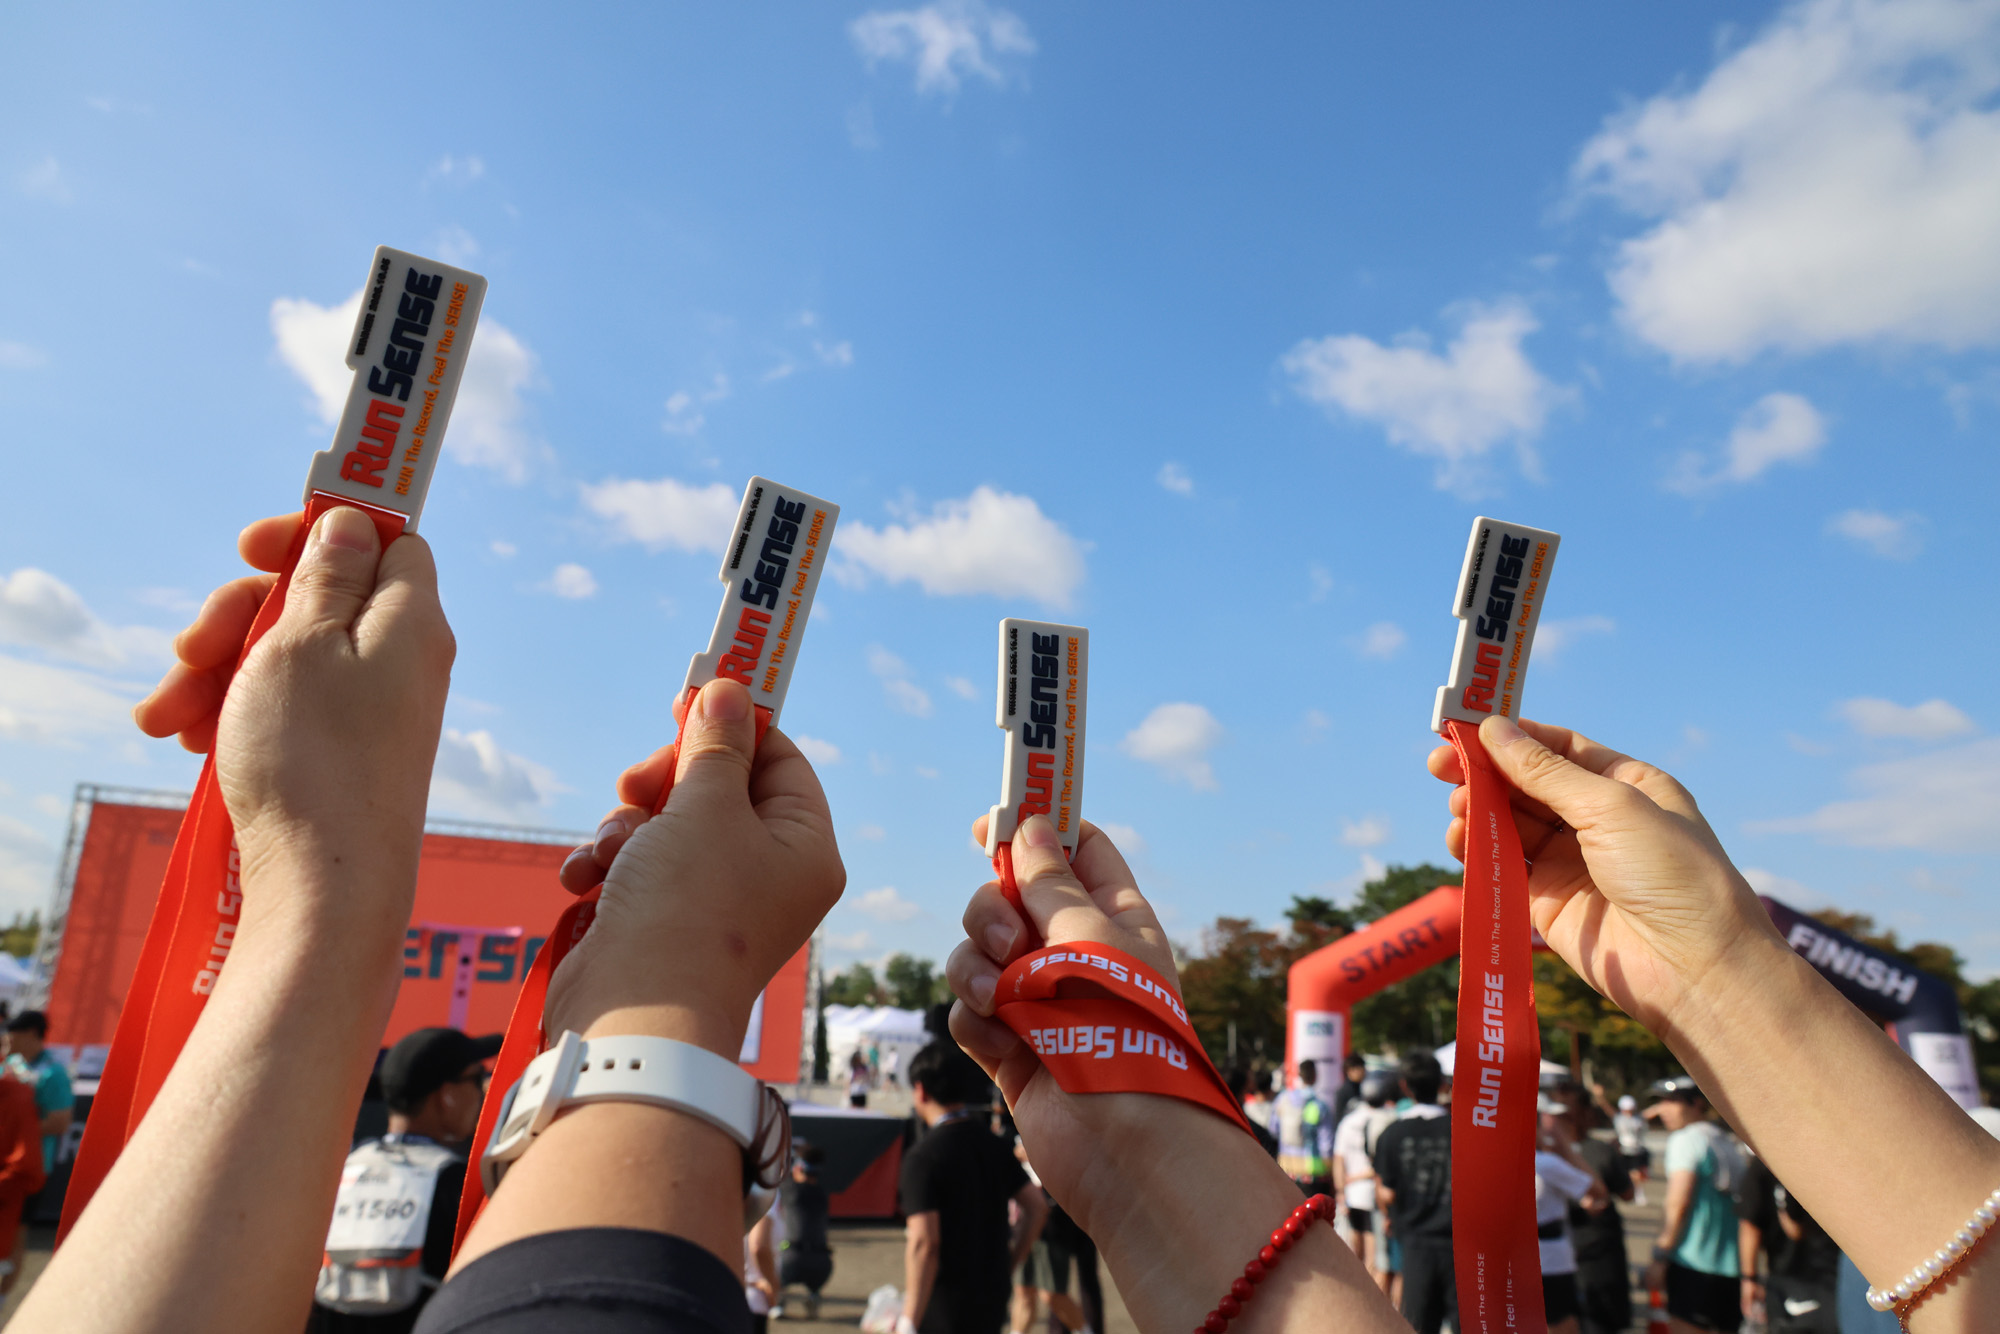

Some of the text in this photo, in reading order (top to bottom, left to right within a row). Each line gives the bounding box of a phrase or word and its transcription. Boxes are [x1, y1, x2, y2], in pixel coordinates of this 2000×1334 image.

[394, 281, 469, 496] RUN The Record, Feel The SENSE
[762, 508, 827, 693] RUN The Record, Feel The SENSE
[1498, 541, 1550, 718] RUN The Record, Feel The SENSE
[1057, 636, 1080, 833] RUN The Record, Feel The SENSE
[1339, 916, 1443, 984] START
[1787, 922, 1919, 1006] FINISH
